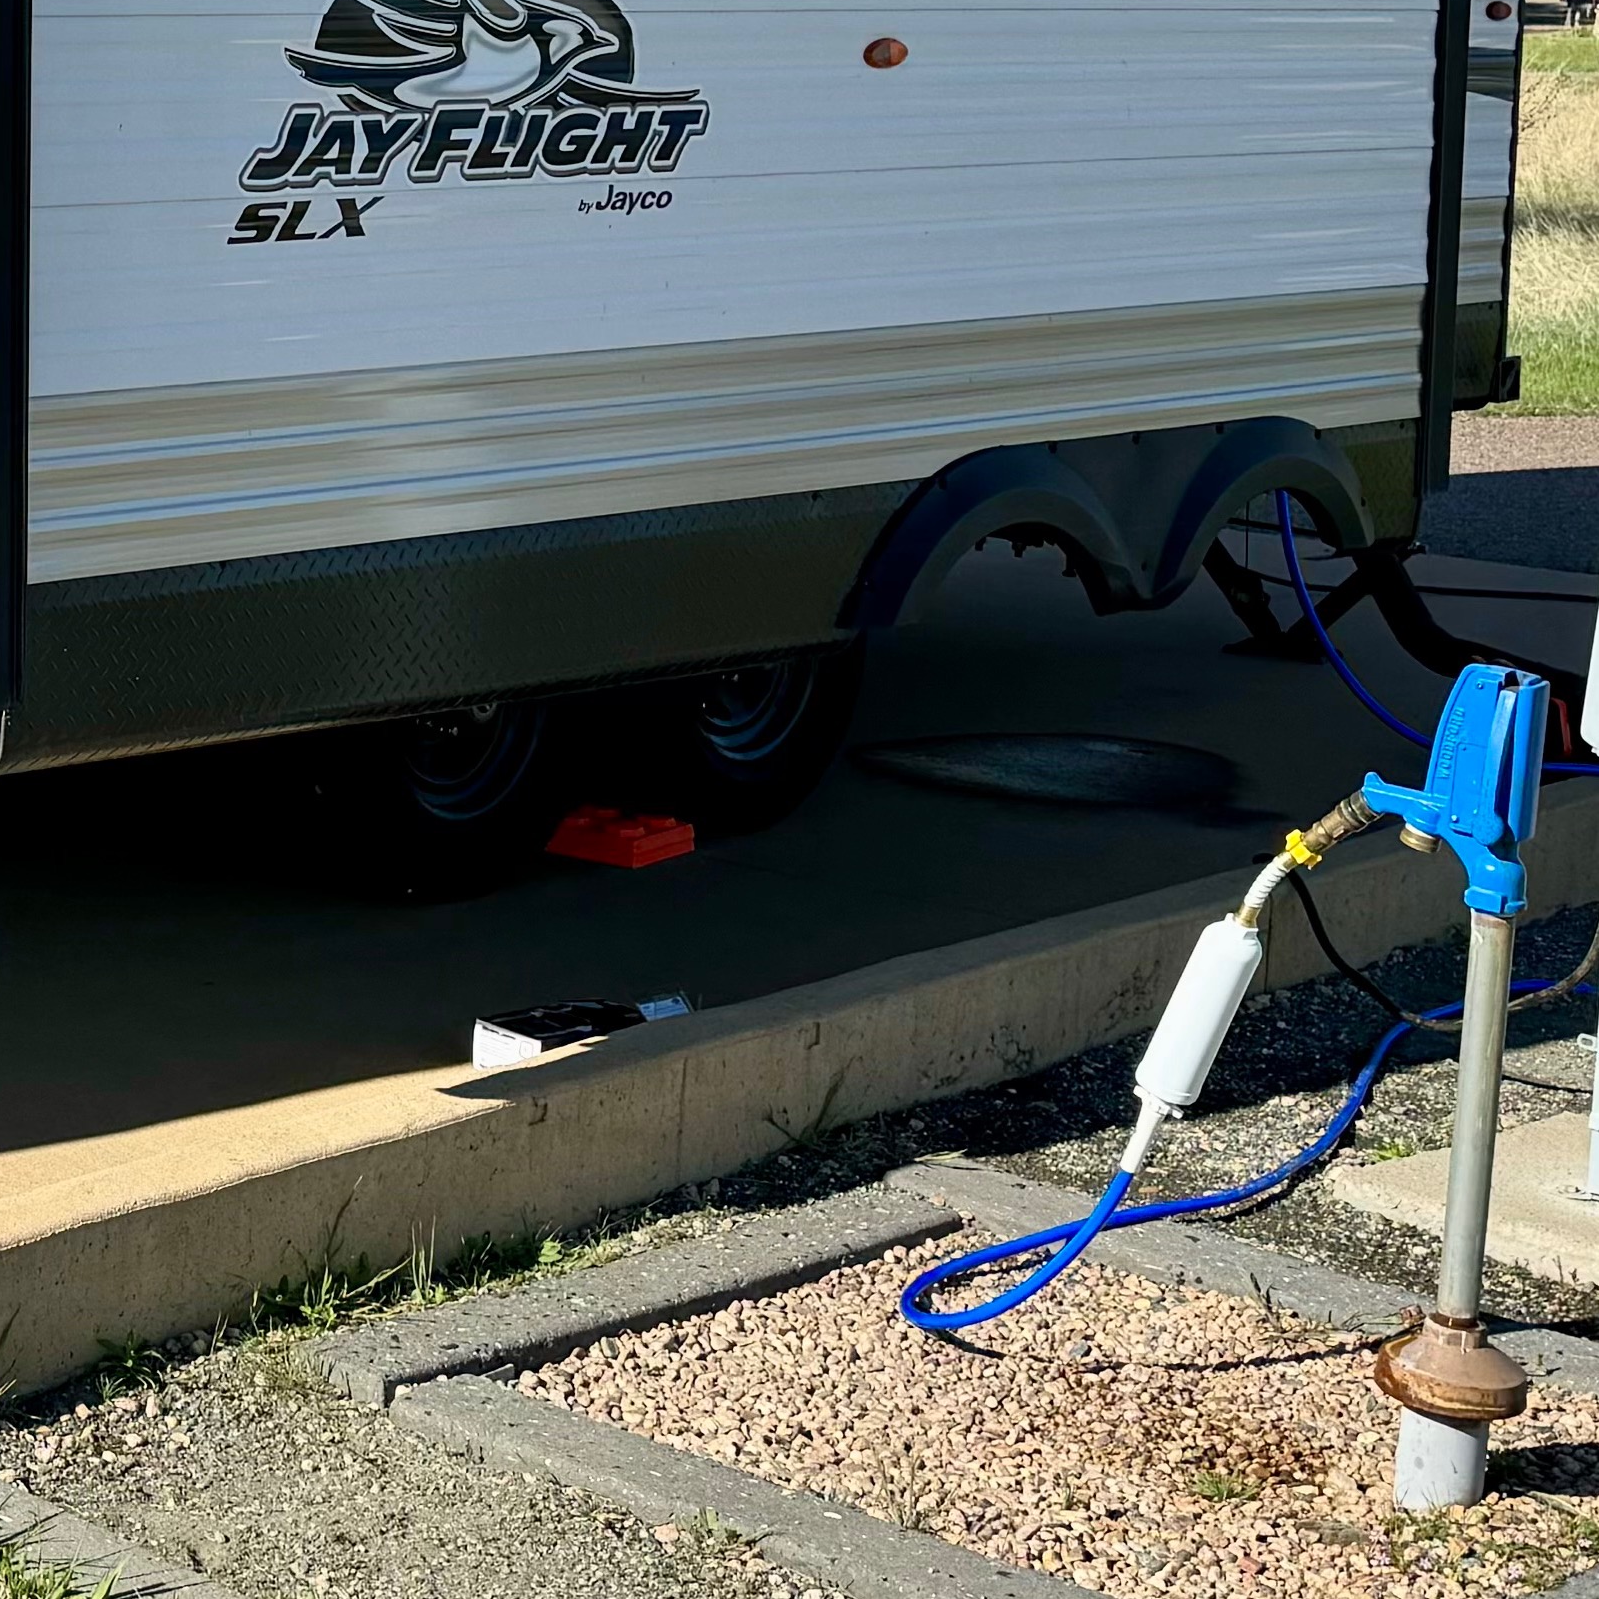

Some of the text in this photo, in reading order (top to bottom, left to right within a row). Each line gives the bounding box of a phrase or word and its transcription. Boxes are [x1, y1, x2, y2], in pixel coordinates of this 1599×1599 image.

[239, 99, 709, 191] JAY FLIGHT
[227, 196, 385, 244] SLX
[578, 184, 673, 216] by Jayco
[1436, 706, 1466, 779] WOODFORD
